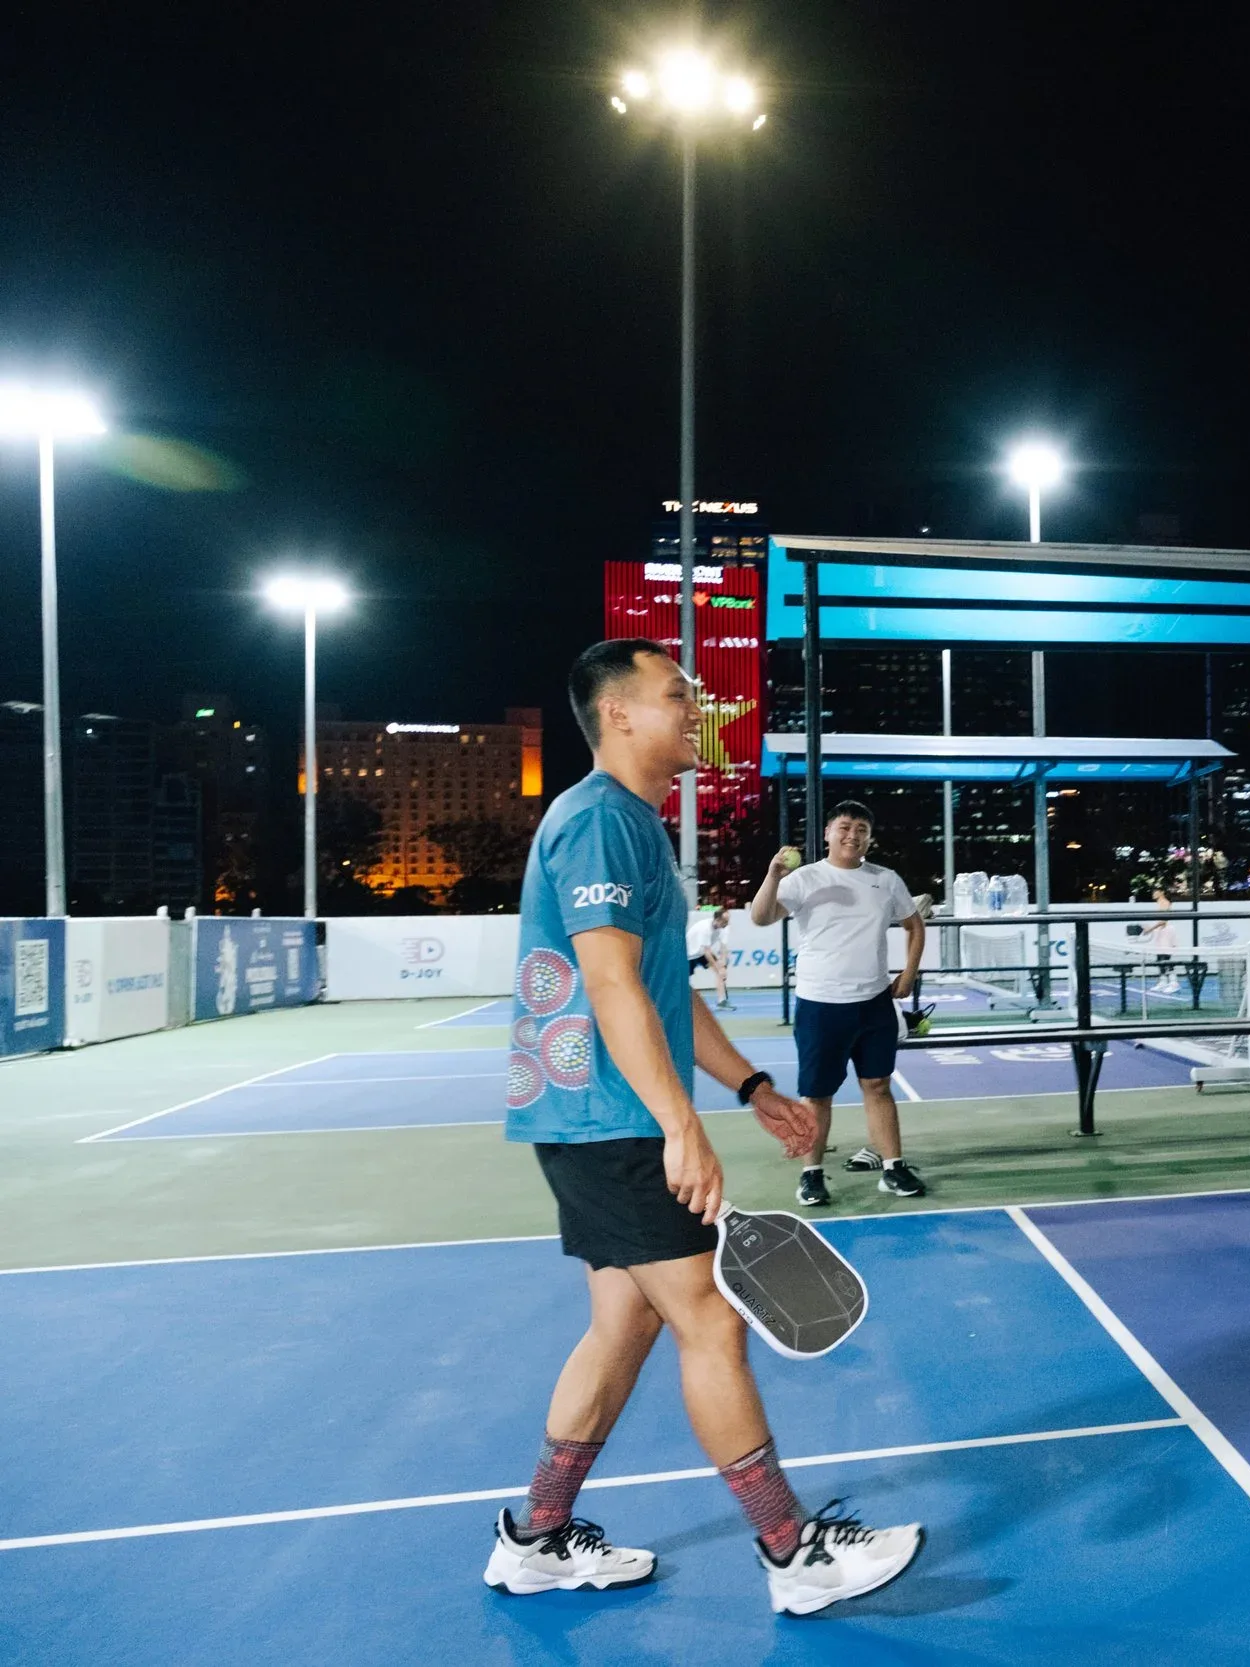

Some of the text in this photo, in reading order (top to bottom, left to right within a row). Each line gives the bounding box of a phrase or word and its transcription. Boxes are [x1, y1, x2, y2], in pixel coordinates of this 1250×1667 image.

[700, 501, 758, 514] NEXUS
[710, 596, 755, 609] VPBank
[732, 1282, 776, 1329] QUARTZ
